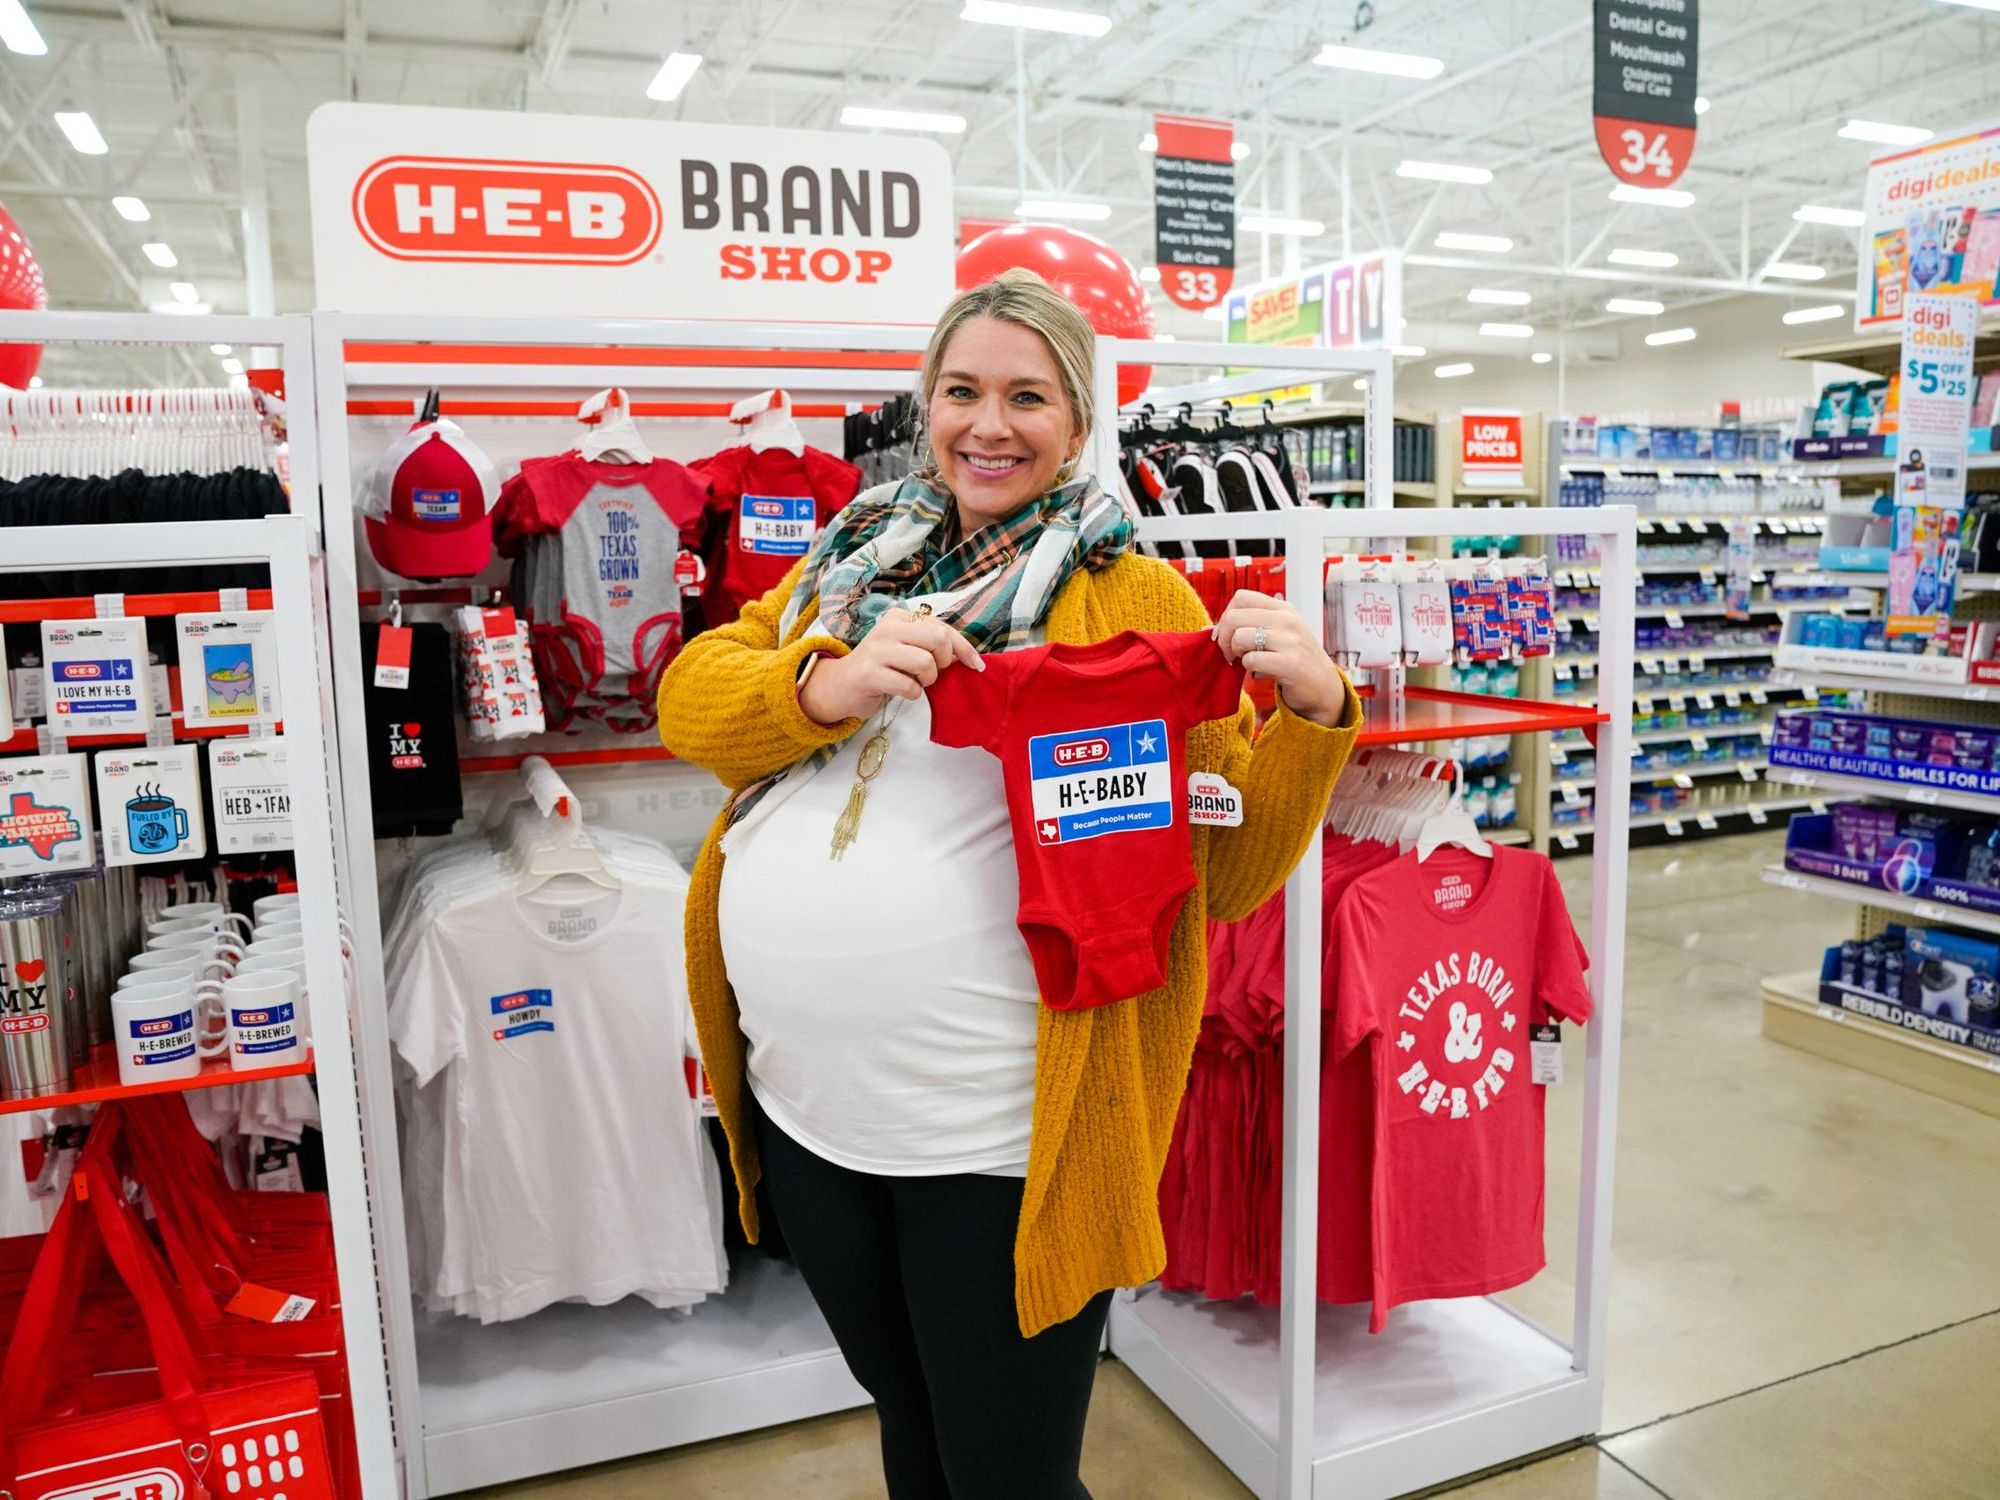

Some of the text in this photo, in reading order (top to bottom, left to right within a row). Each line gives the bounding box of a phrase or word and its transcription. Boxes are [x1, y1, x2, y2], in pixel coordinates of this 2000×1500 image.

[1609, 11, 1687, 41] Dental Care
[1610, 40, 1686, 67] Mouthwash
[1622, 66, 1673, 85] Children's
[1623, 79, 1672, 98] Oral Care
[1619, 128, 1673, 177] 34
[680, 158, 921, 239] BRAND
[393, 183, 626, 239] H-E-B
[1160, 231, 1232, 250] Men's Shaving
[719, 244, 892, 284] SHOP
[1173, 250, 1220, 265] Sun Care
[1176, 270, 1218, 303] 33
[1913, 307, 1951, 329] digi
[1913, 327, 1964, 349] deals
[1941, 363, 1965, 375] OFF
[1473, 424, 1509, 441] LOW
[1466, 440, 1518, 458] PRICES
[606, 511, 640, 534] 100%
[600, 535, 637, 557] TEXAS
[599, 559, 639, 581] GROWN
[64, 686, 86, 698] LOVE
[89, 685, 102, 697] MY
[105, 684, 131, 696] H-E-B
[389, 724, 401, 739] I
[390, 739, 421, 755] MY
[1059, 743, 1104, 761] H-E-B
[104, 765, 129, 773] BRAND
[1773, 749, 1828, 770] HEALTHY,
[1829, 755, 1895, 778] BEAUTIFUL
[1897, 766, 1946, 785] SMILES
[1948, 771, 1978, 788] FOR
[1059, 771, 1147, 809] H-E-BABY
[226, 797, 252, 816] HEB
[637, 787, 723, 813] H-E-B
[1188, 795, 1236, 813] BRAND
[3, 811, 68, 827] HOWDY
[132, 809, 172, 821] FUELED BY
[1100, 815, 1126, 824] People
[1127, 812, 1153, 821] Matter
[1194, 811, 1227, 820] SHOP
[1842, 865, 1871, 882] DAYS
[1434, 883, 1473, 904] BRAND
[1934, 884, 1970, 903] 100%
[548, 918, 598, 935] BRAND
[1398, 951, 1514, 1021] TEXAS BORN
[0, 985, 47, 1013] MY
[4, 1017, 44, 1031] H-E-B
[508, 1009, 541, 1025] HOWDY
[1841, 992, 1904, 1025] REBUILD
[1904, 1010, 1972, 1044] DENSITY
[139, 1032, 192, 1051] H-E-BREWED
[238, 1025, 291, 1041] H-E-BREWED
[1444, 1001, 1483, 1064] &
[1397, 1060, 1468, 1119] H-E-B
[1472, 1047, 1515, 1110] FED
